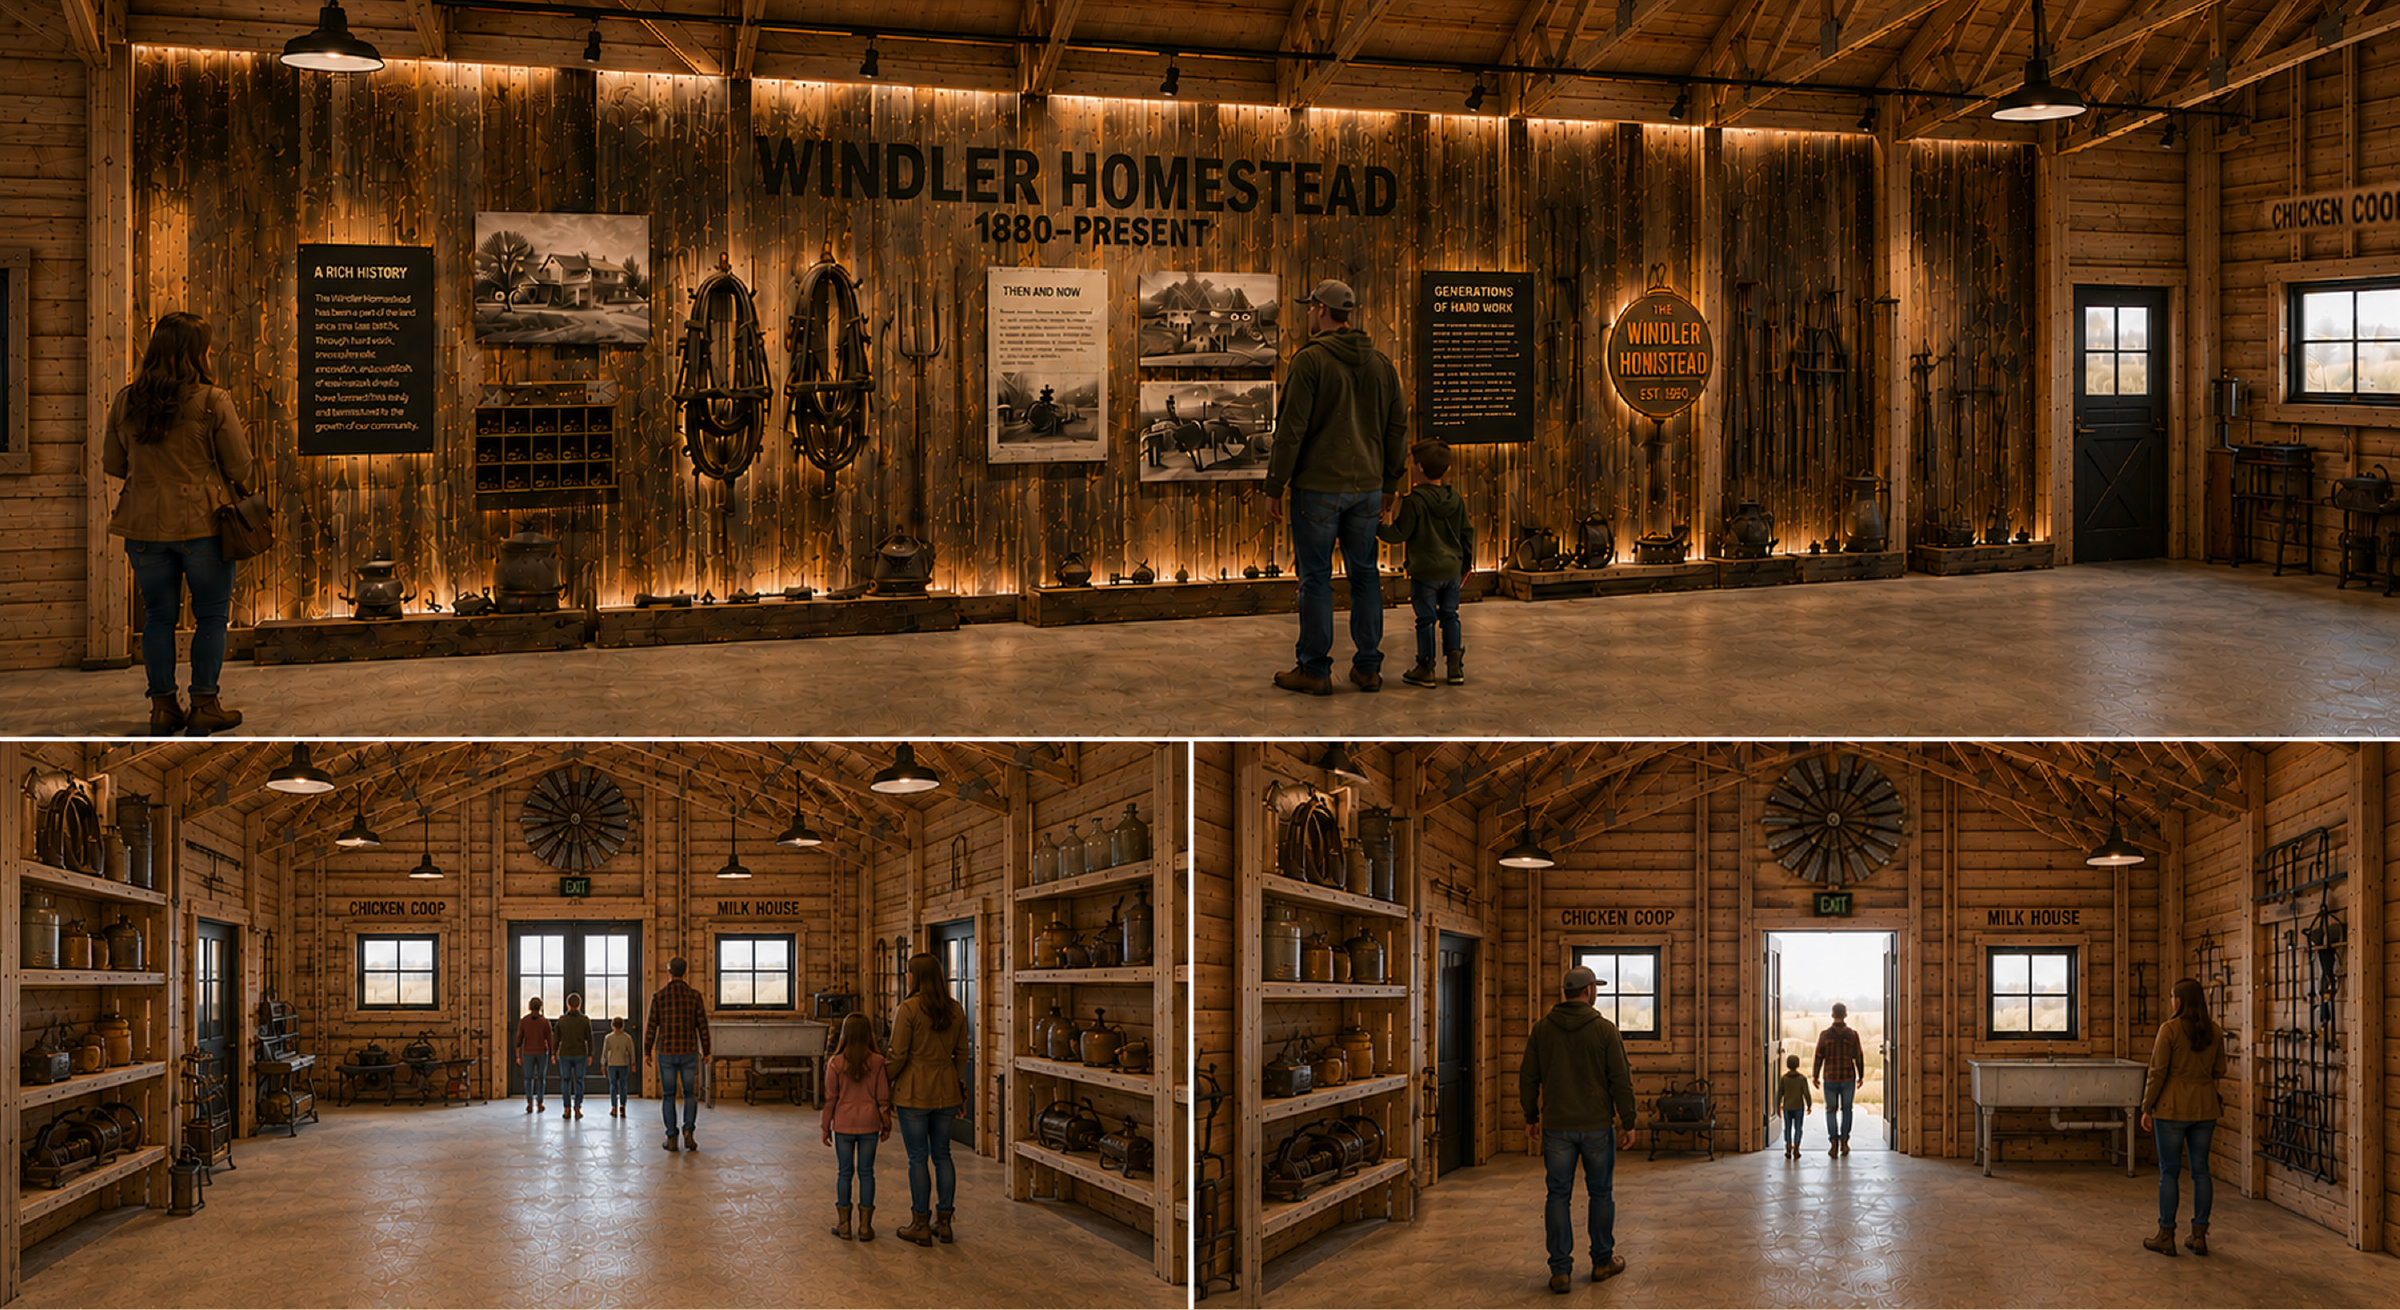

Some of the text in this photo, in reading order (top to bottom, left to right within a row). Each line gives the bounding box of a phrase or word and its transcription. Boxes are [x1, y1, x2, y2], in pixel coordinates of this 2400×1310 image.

[755, 136, 1396, 216] WINDLER HOMESTEAD
[2272, 197, 2343, 231] CHICKEN
[314, 266, 408, 279] A RICH HISTORY
[1003, 286, 1081, 297] THEN AND NOW
[1434, 286, 1514, 298] GENERATIONS
[1433, 302, 1447, 313] OF
[1482, 302, 1513, 313] WORK
[1653, 304, 1673, 315] THE
[1627, 321, 1701, 345] WINDLER
[349, 901, 446, 916] CHICKEN COOP
[717, 901, 799, 916] MILK HOUSE
[1561, 910, 1675, 926] CHICKEN COOP
[1987, 909, 2080, 926] MILK HOUSE
